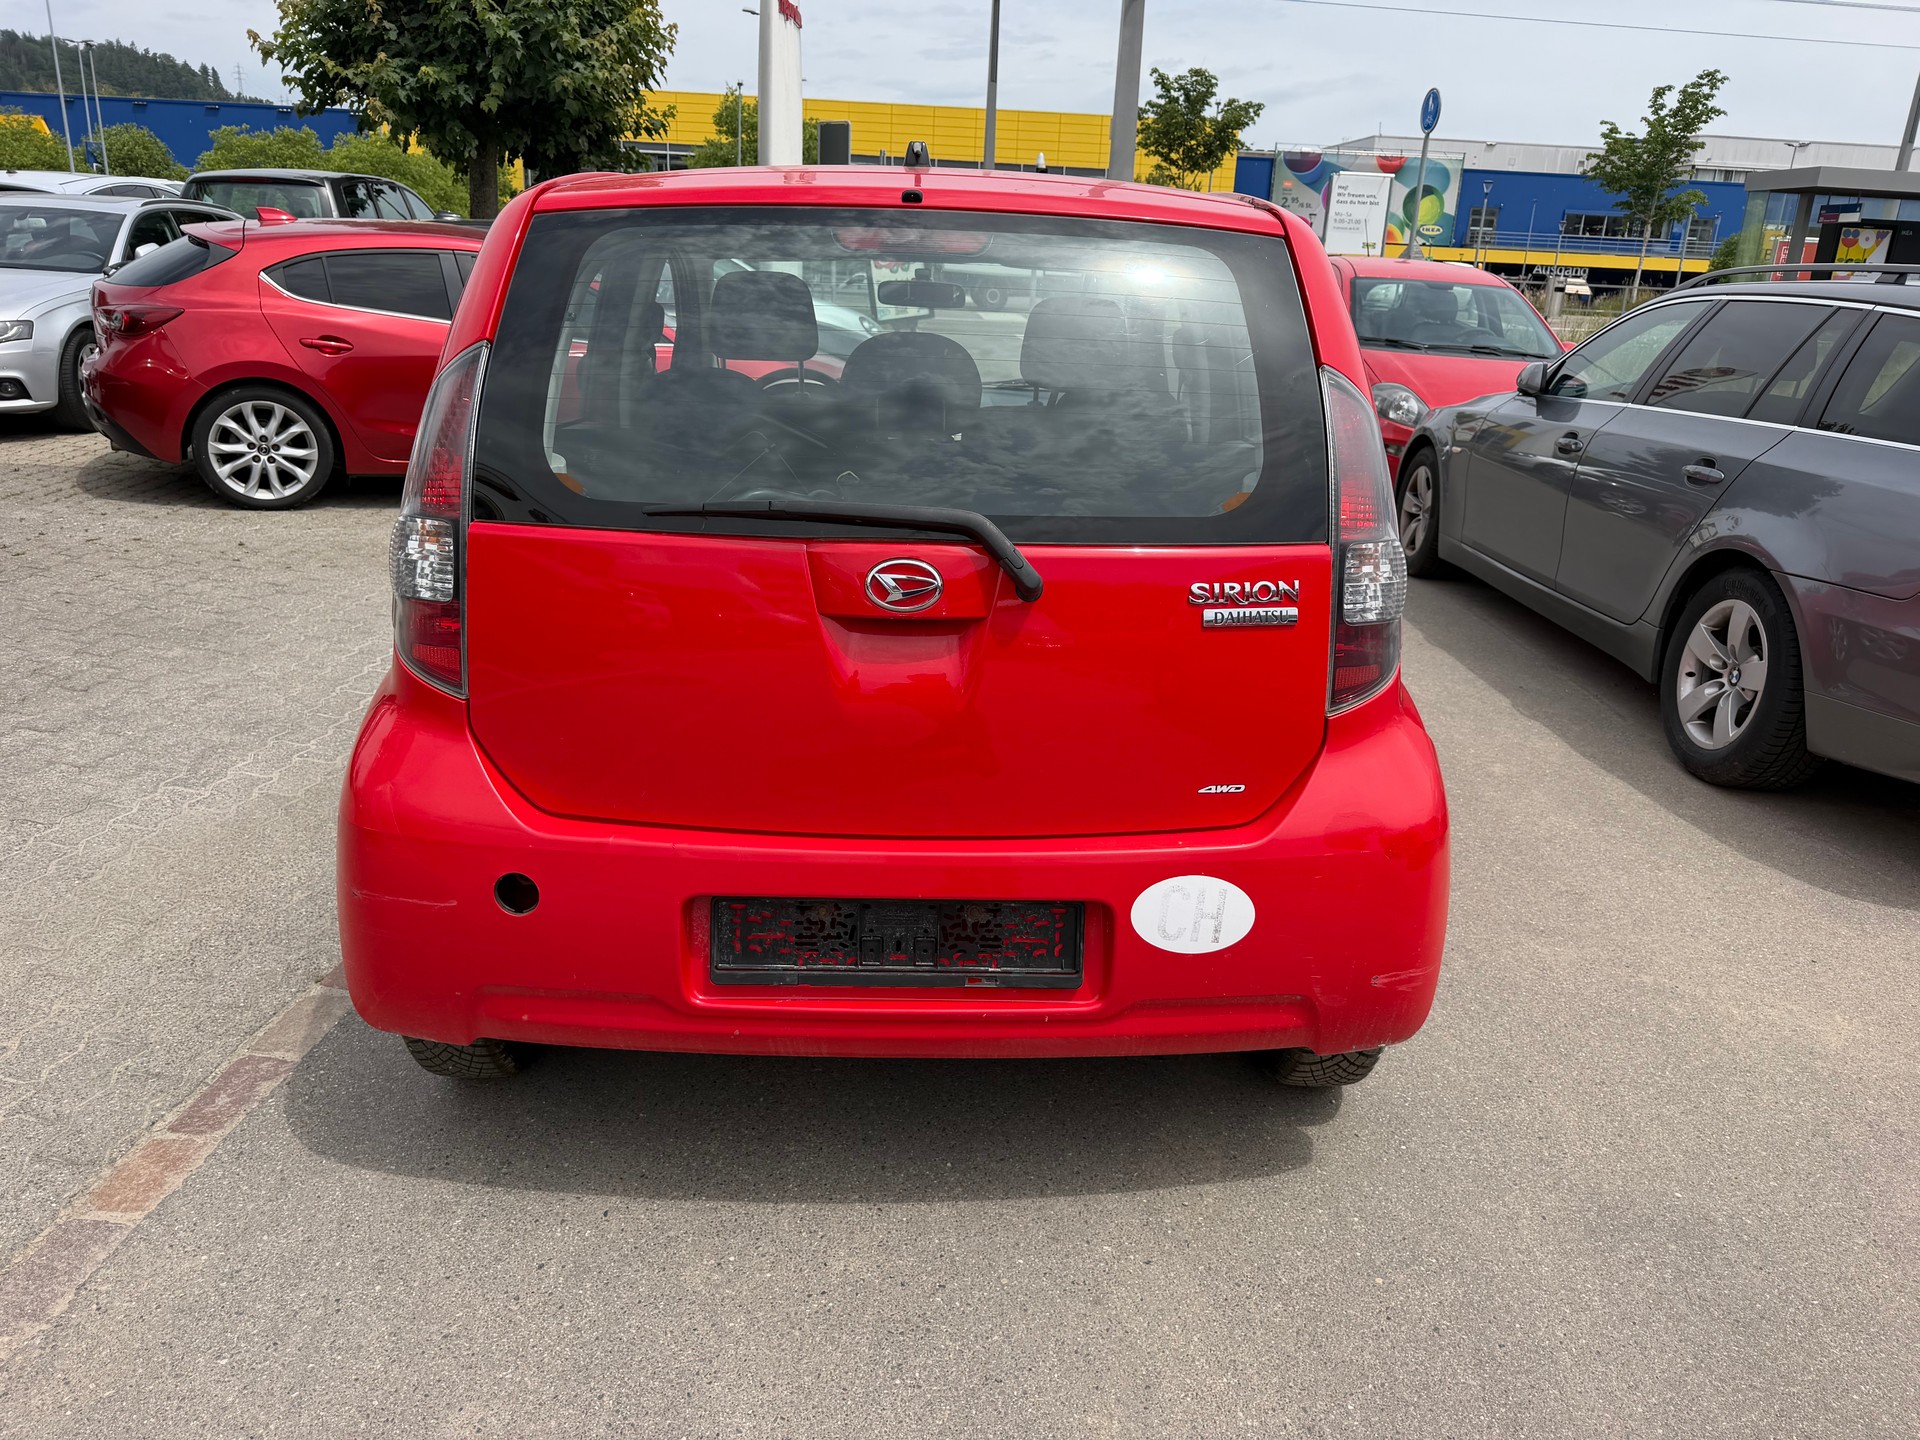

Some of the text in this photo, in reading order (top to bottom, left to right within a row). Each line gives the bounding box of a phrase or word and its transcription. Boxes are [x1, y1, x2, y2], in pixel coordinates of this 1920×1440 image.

[1532, 265, 1589, 280] Ausgang
[1188, 579, 1300, 605] SIRION
[1213, 609, 1289, 625] DAIHATSU
[1197, 784, 1246, 794] 4WD
[1157, 884, 1228, 944] CH
